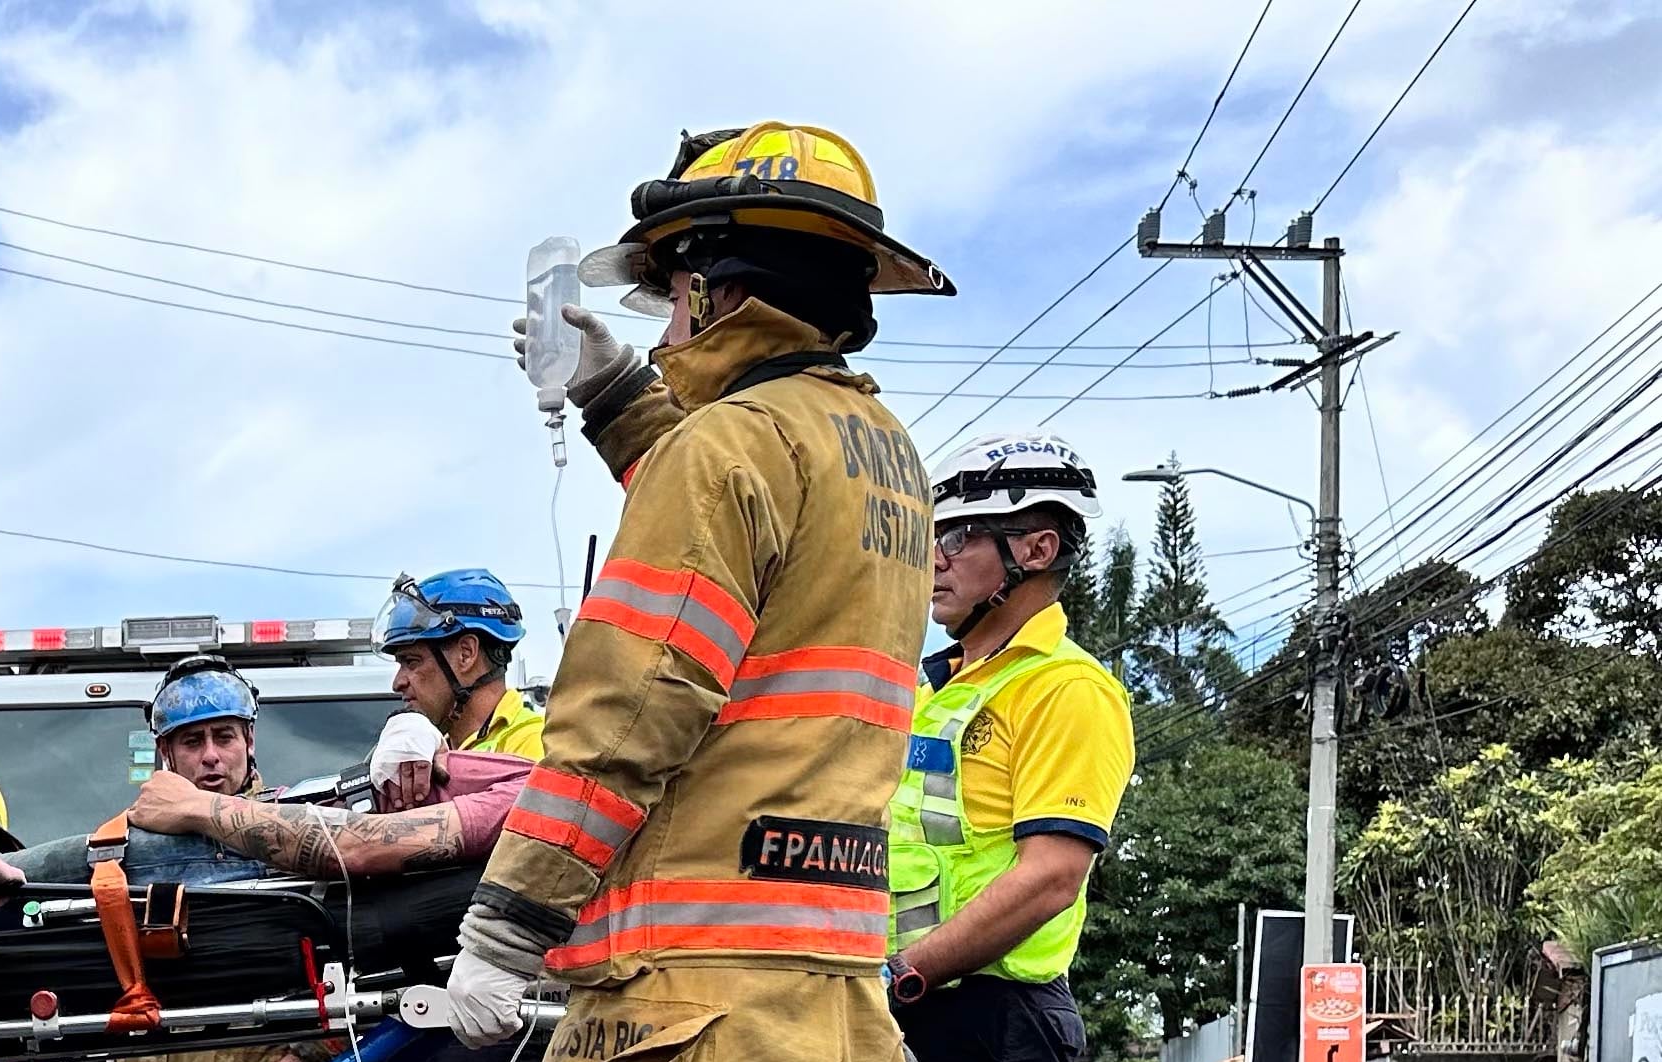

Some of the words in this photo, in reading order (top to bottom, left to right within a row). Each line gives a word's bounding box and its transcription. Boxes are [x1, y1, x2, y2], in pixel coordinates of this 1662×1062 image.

[735, 156, 799, 180] 718
[986, 441, 1080, 466] RESCATE
[1064, 796, 1086, 808] INS
